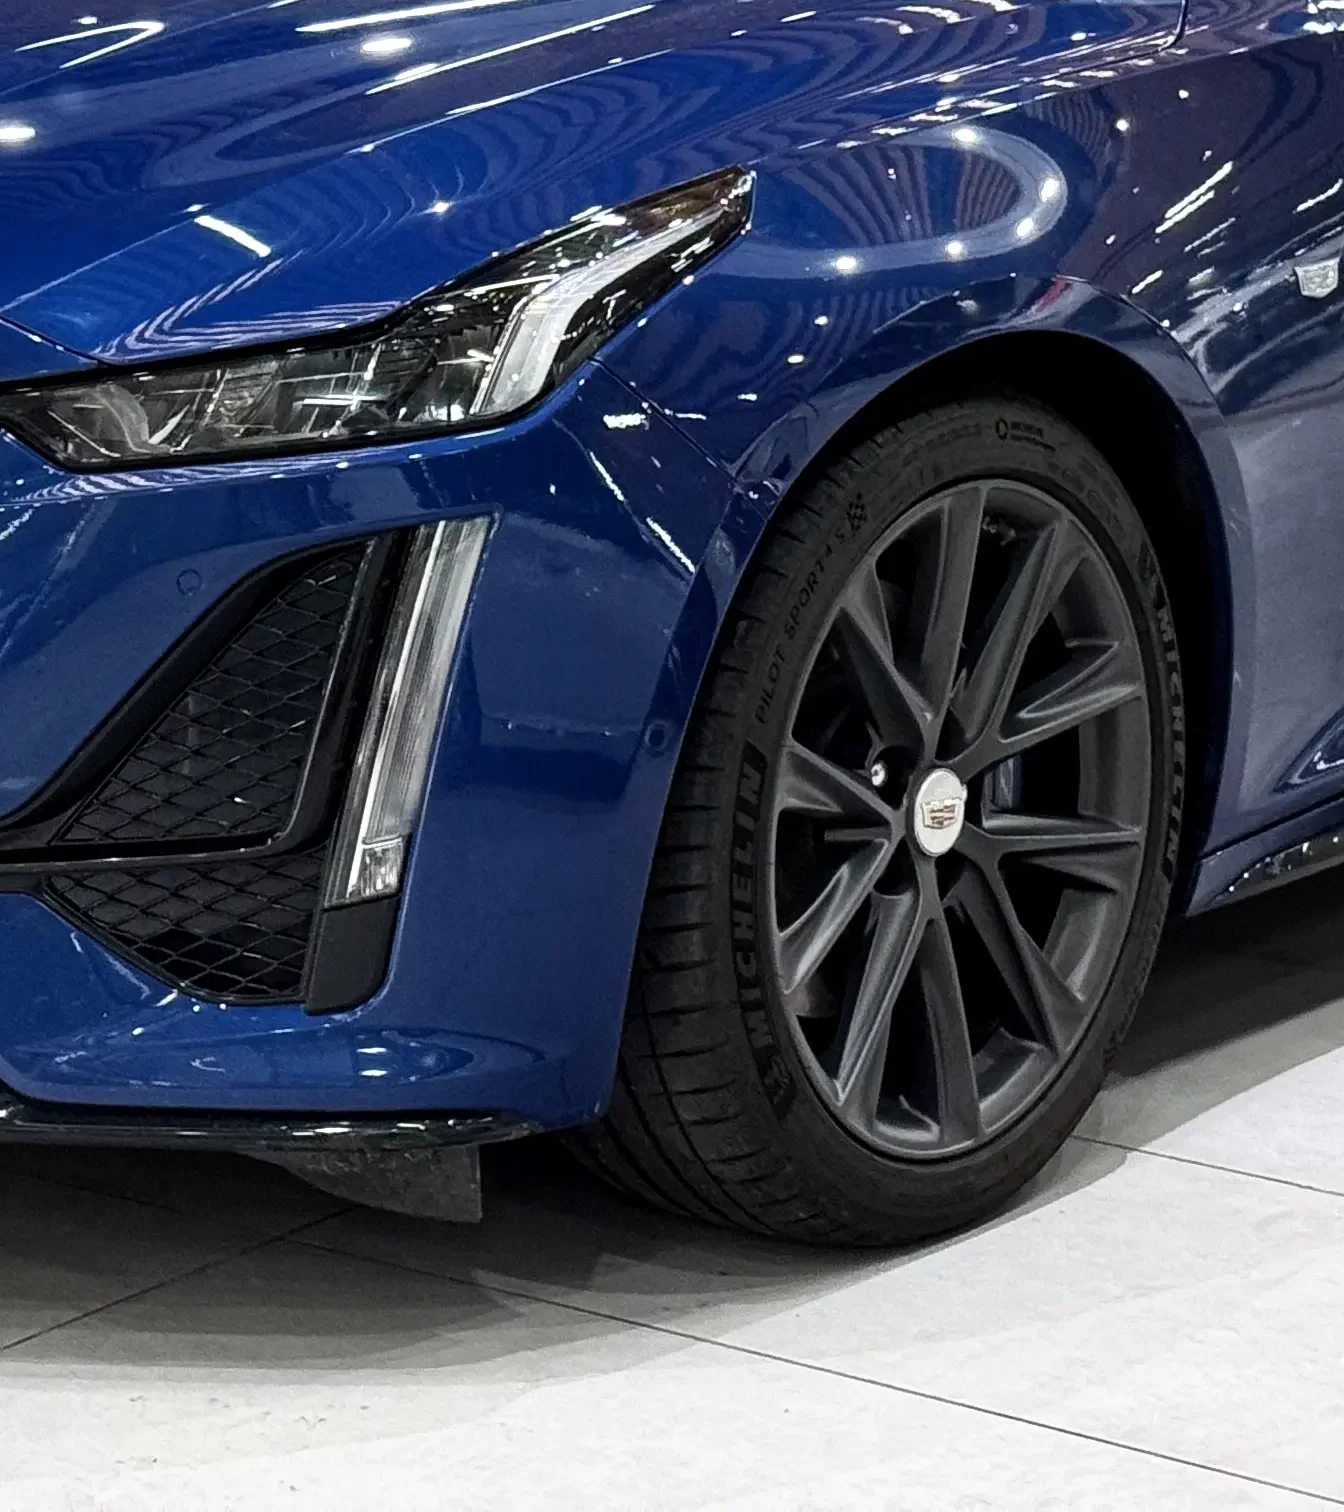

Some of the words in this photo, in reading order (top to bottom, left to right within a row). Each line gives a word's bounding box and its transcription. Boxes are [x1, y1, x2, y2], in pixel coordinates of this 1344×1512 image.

[755, 648, 786, 724] PILOT
[784, 559, 825, 640] SPORT
[731, 759, 774, 1050] MICHELIN
